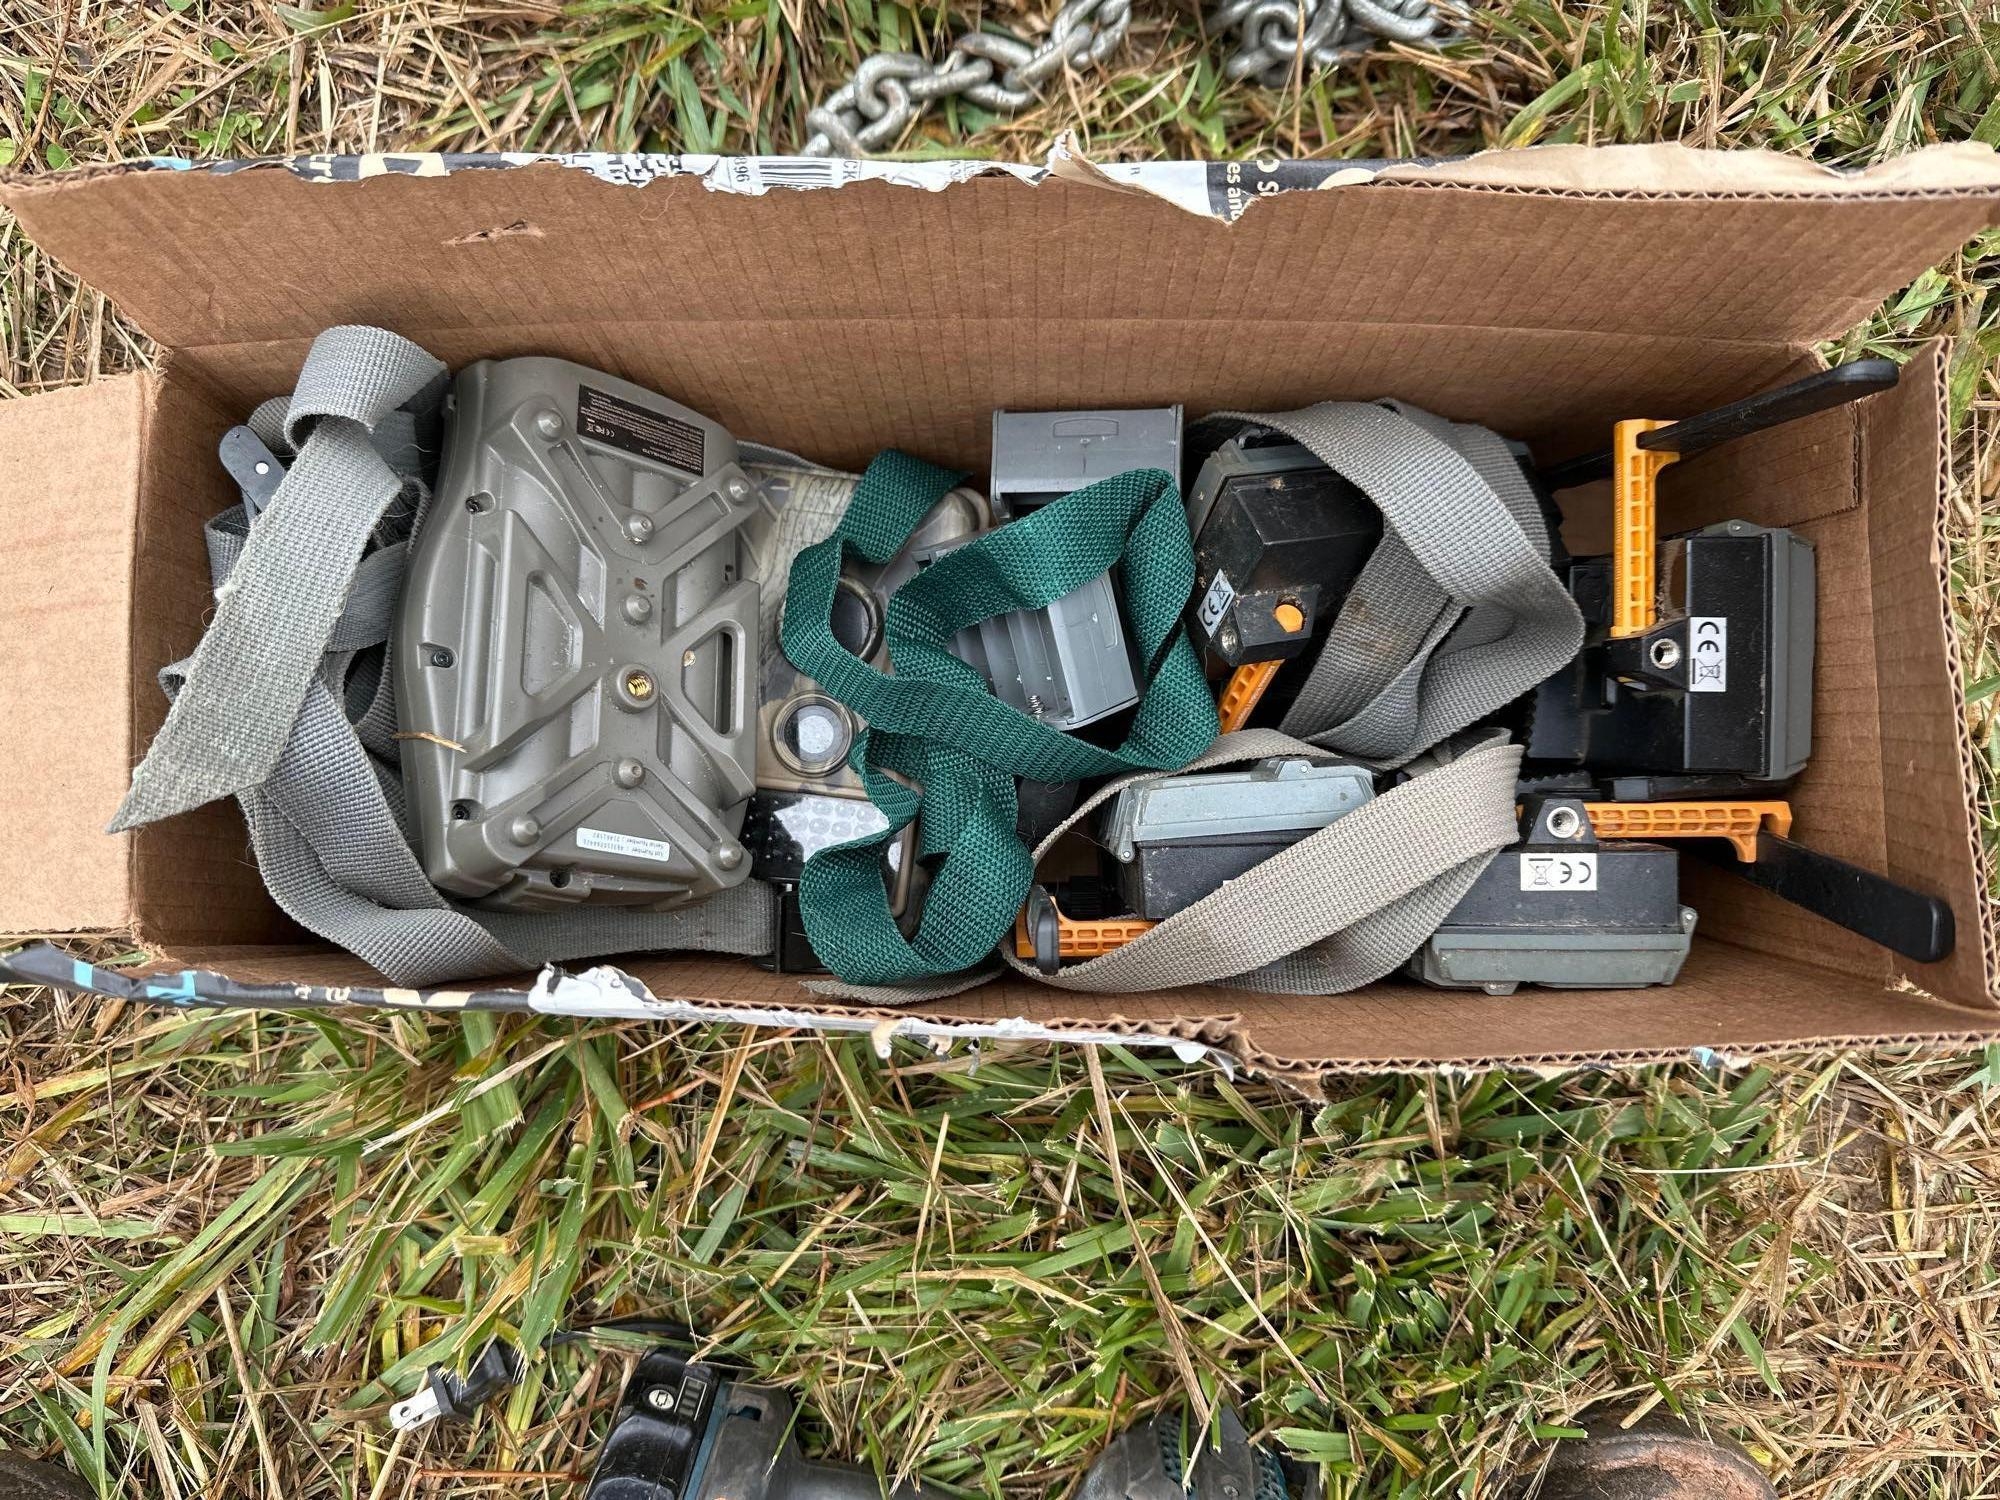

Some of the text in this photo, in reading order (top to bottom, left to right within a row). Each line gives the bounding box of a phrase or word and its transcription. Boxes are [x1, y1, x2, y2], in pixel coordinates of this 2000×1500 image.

[1202, 597, 1220, 627] CE
[1698, 621, 1720, 652] CE
[1559, 861, 1592, 884] CE
